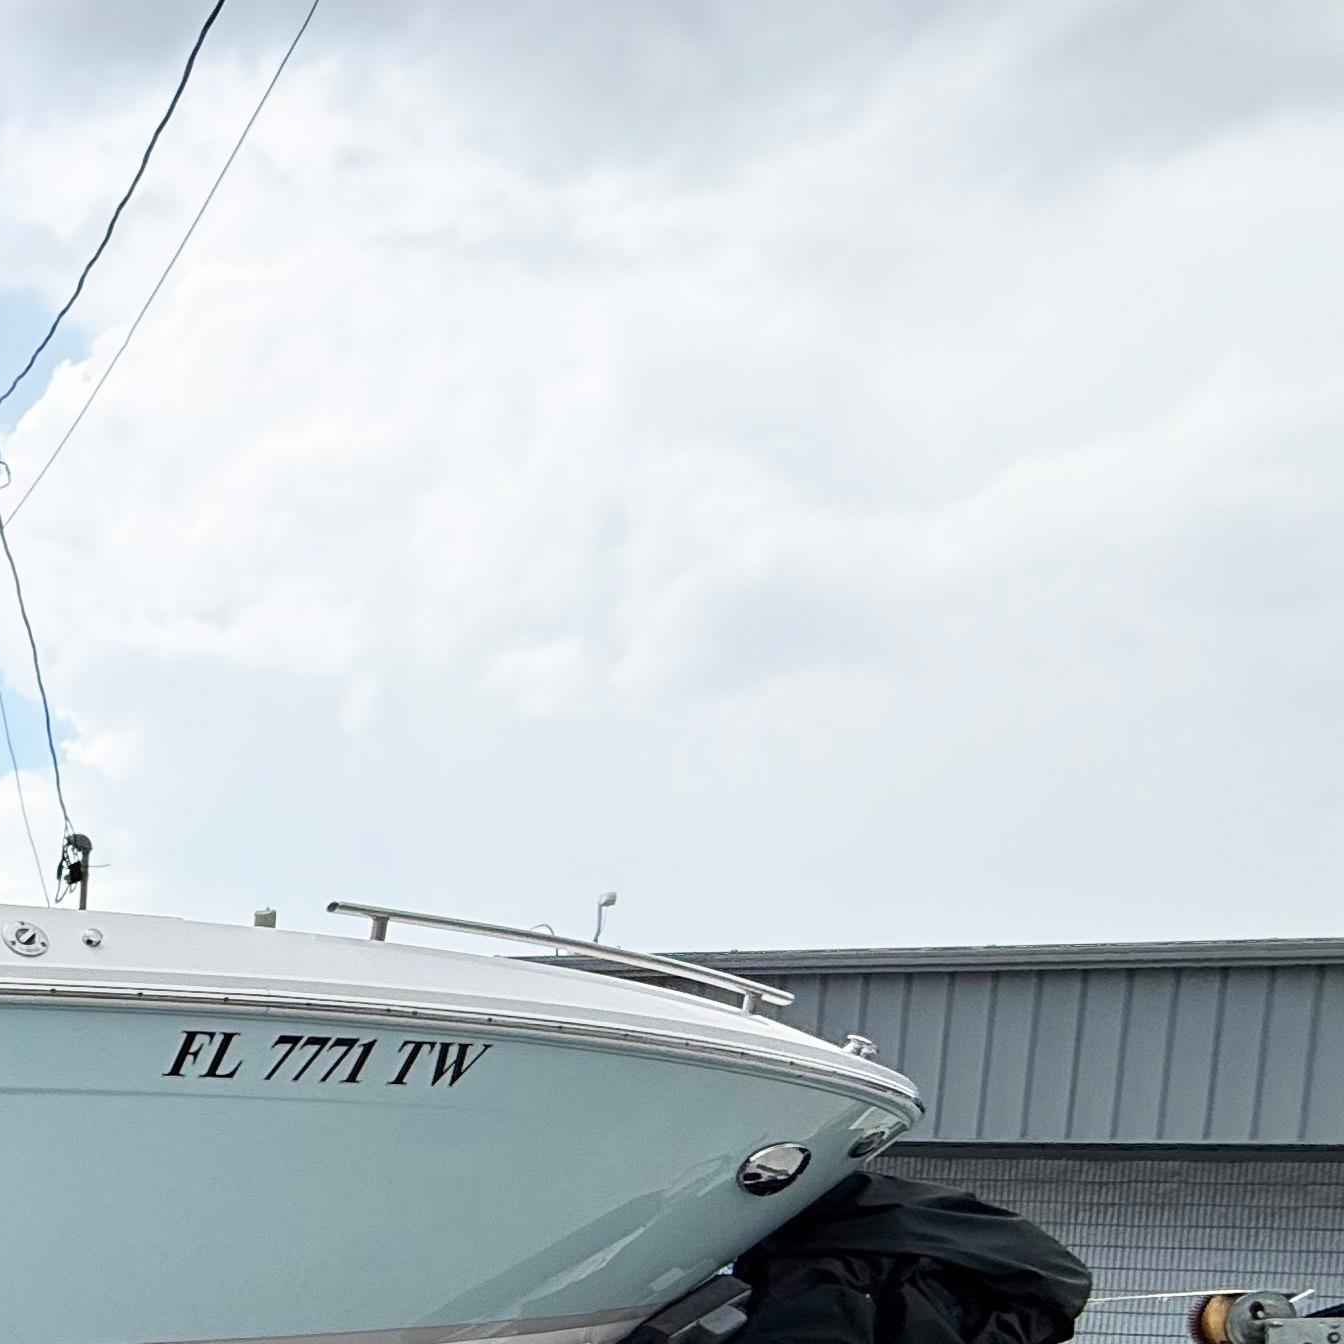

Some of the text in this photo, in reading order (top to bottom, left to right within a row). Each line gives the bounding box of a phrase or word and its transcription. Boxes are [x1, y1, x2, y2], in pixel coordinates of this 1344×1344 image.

[162, 1030, 493, 1087] FL 7771 TW
